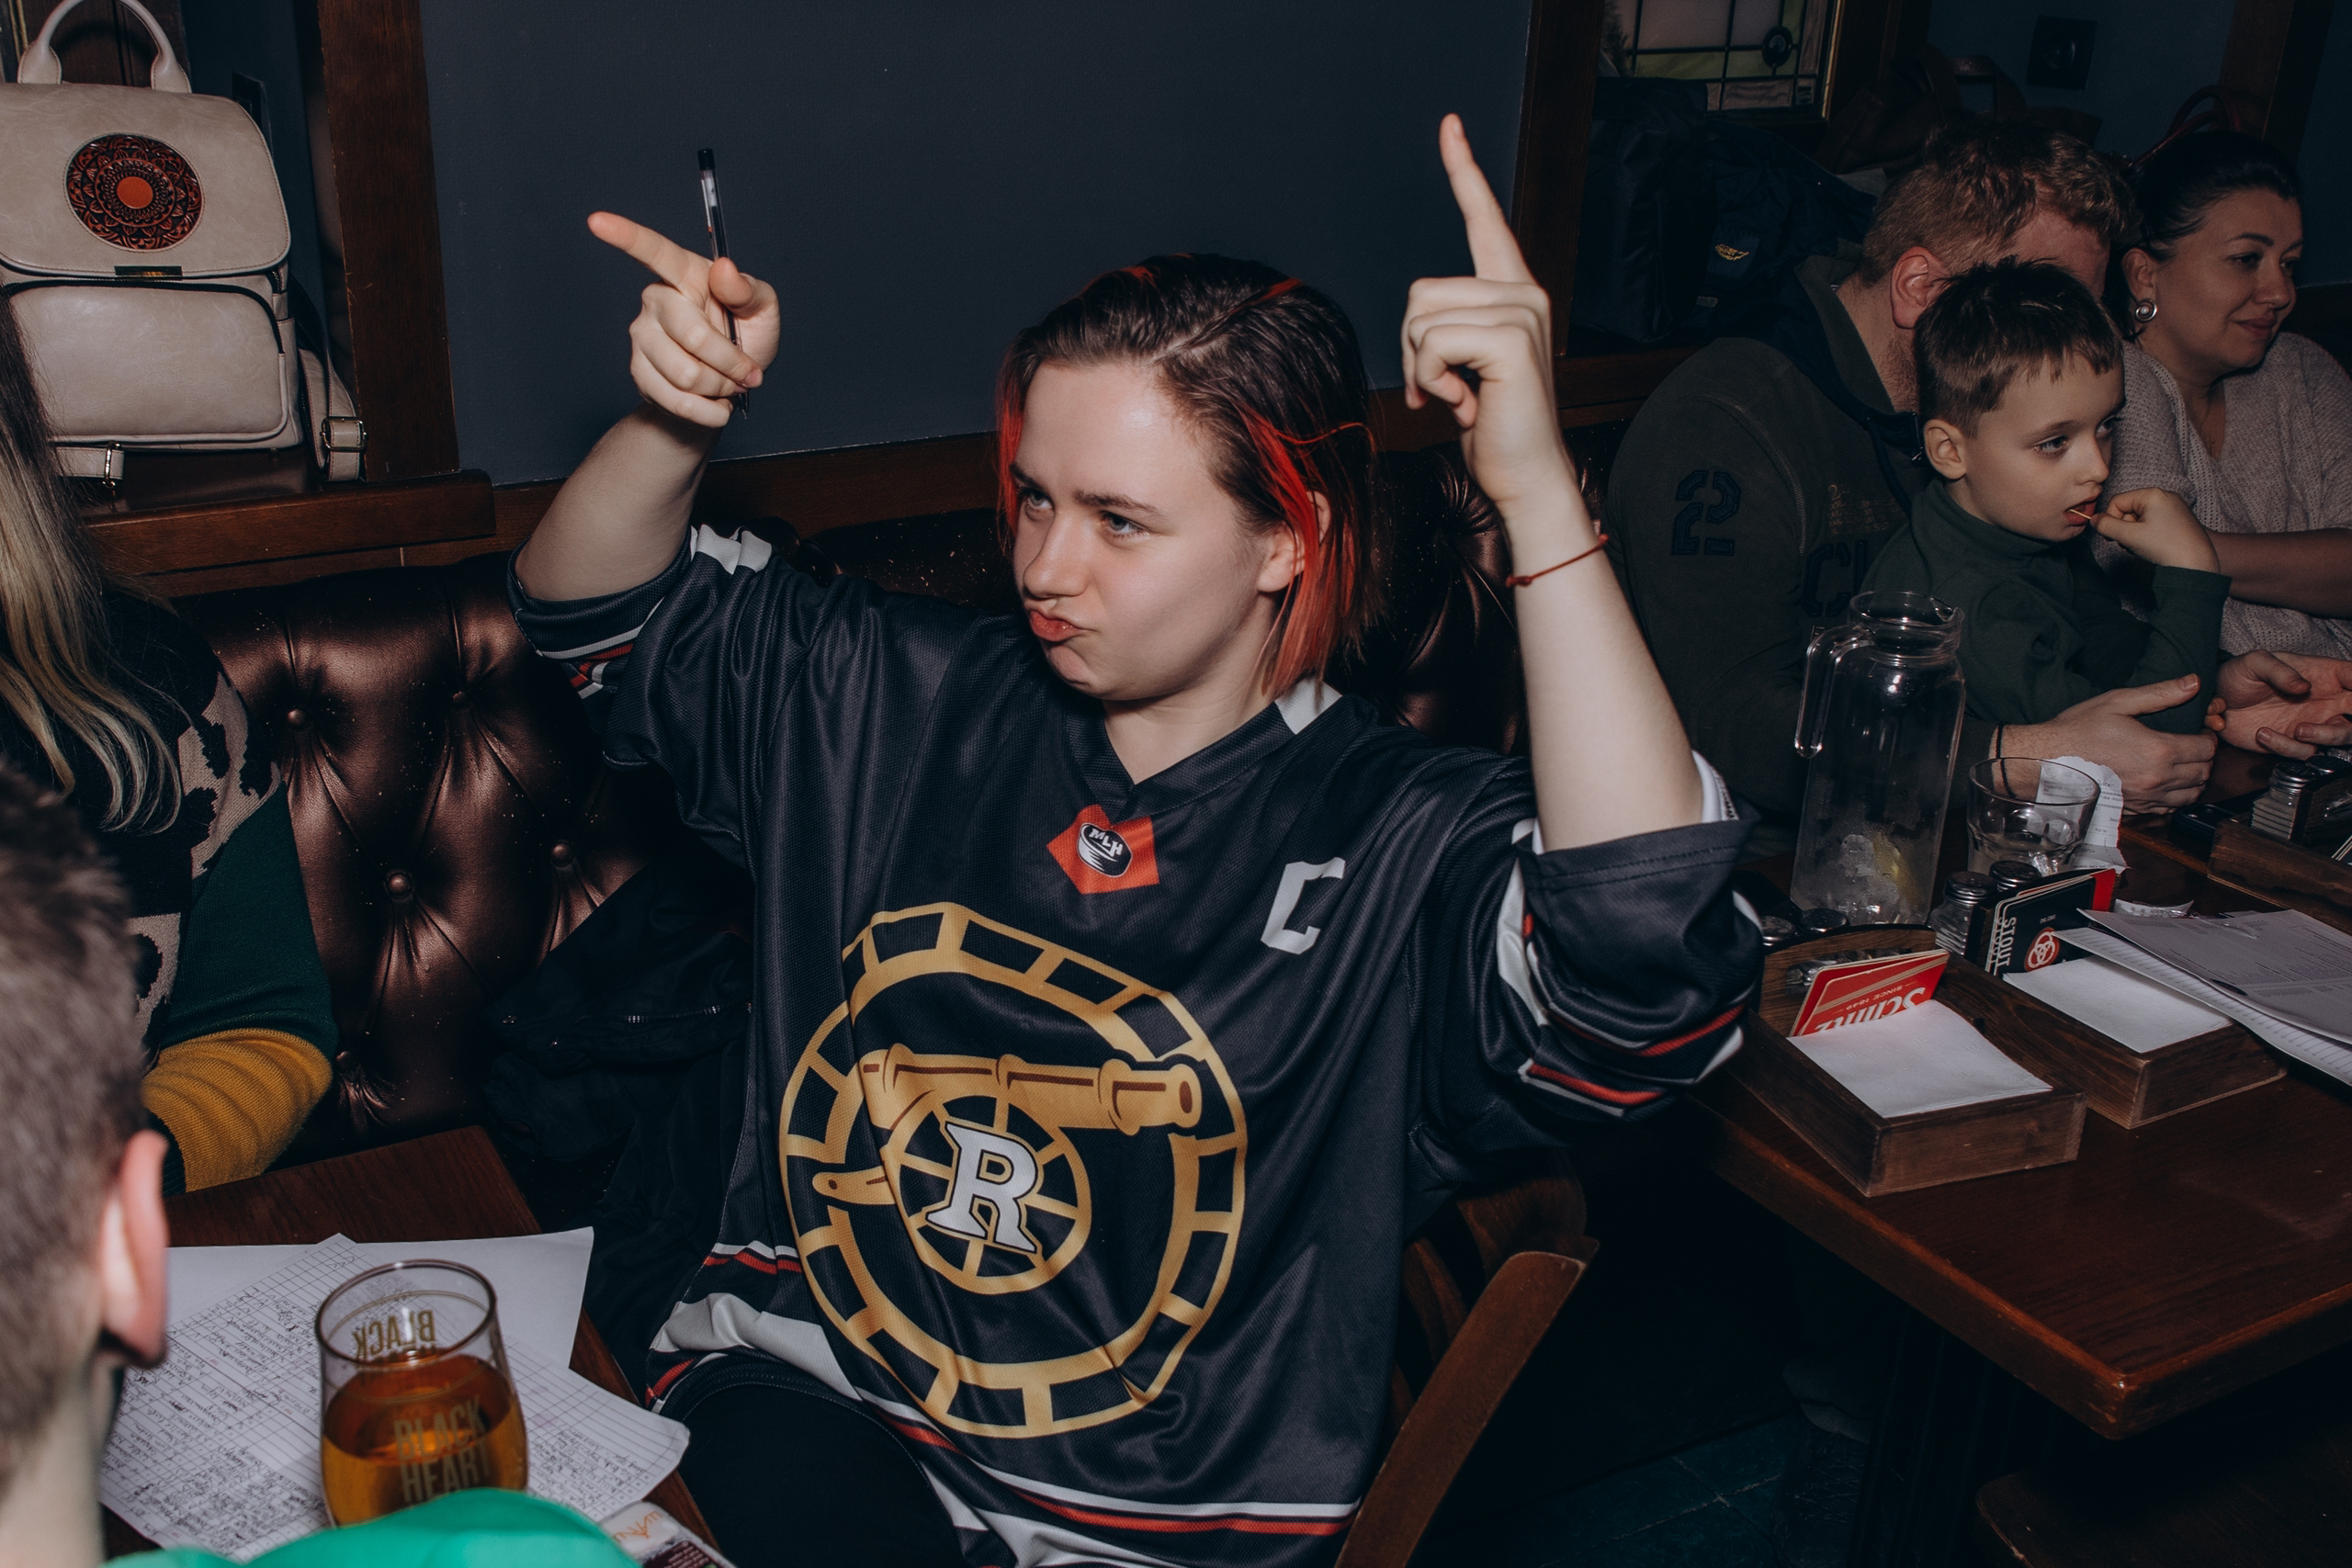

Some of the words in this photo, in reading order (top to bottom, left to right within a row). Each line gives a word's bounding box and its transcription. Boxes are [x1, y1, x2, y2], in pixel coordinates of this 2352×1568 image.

[1672, 469, 1741, 555] 2
[1087, 827, 1124, 857] MLH
[1261, 857, 1346, 954] C
[1996, 916, 2017, 966] STOUT
[1872, 985, 1903, 1000] SINCE
[926, 1122, 1039, 1254] R
[393, 1393, 486, 1461] BLACK
[401, 1438, 490, 1503] HEART
